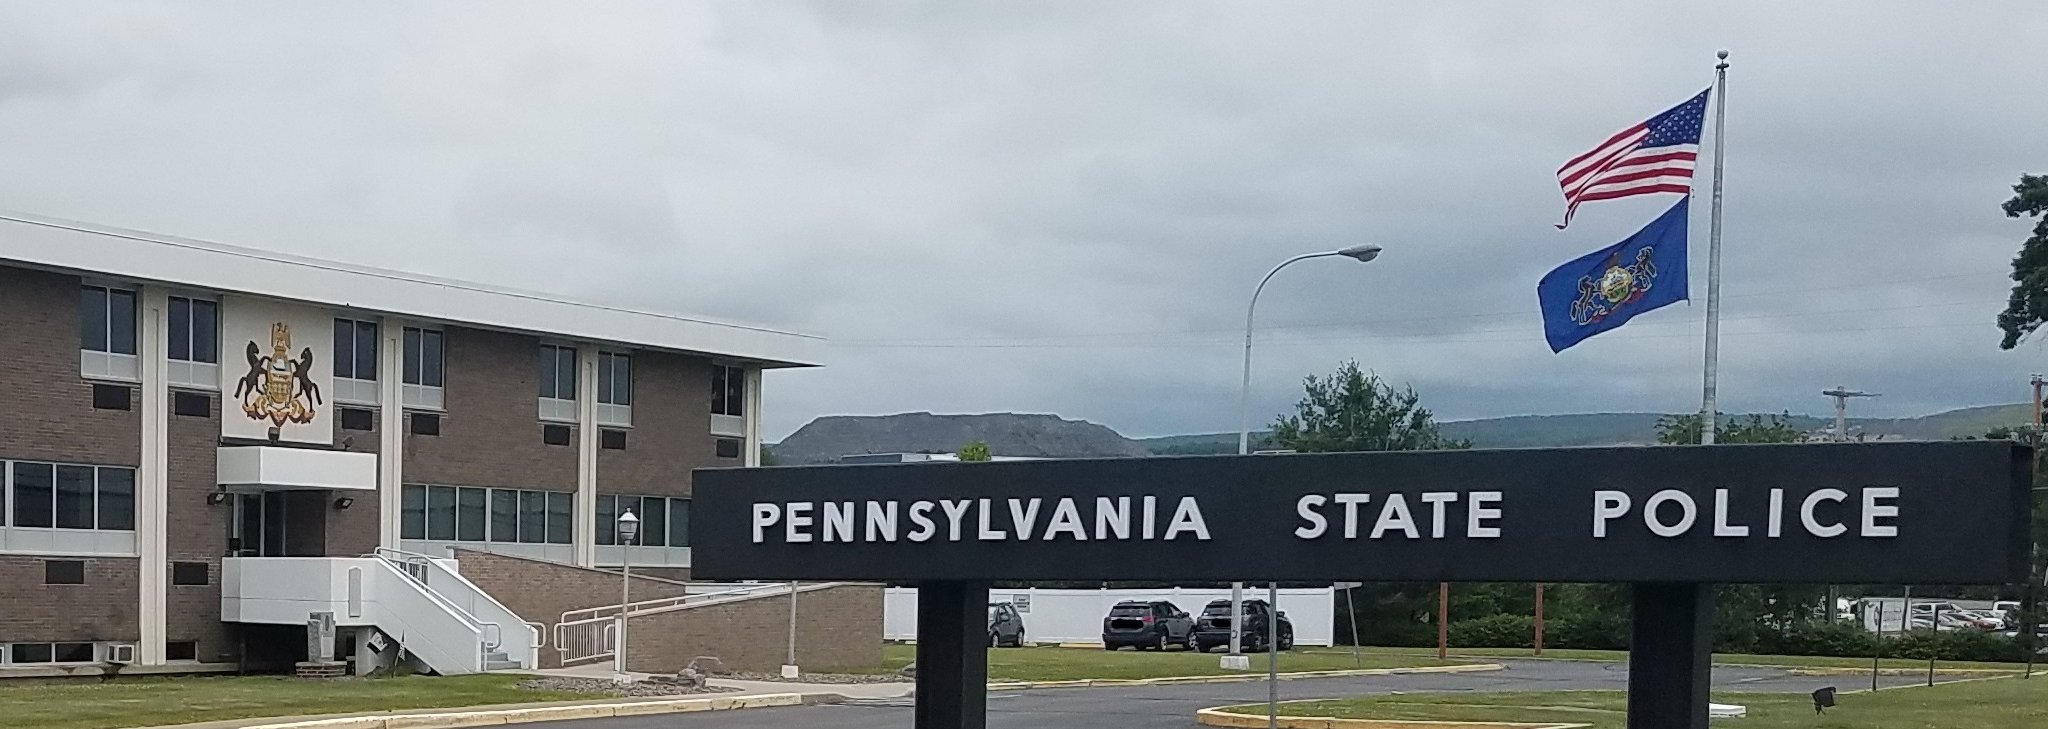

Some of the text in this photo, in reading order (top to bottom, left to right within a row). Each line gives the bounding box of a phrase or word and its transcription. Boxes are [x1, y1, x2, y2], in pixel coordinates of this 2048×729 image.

[753, 487, 1899, 543] PENNSYLVANIA STATE POLICE
